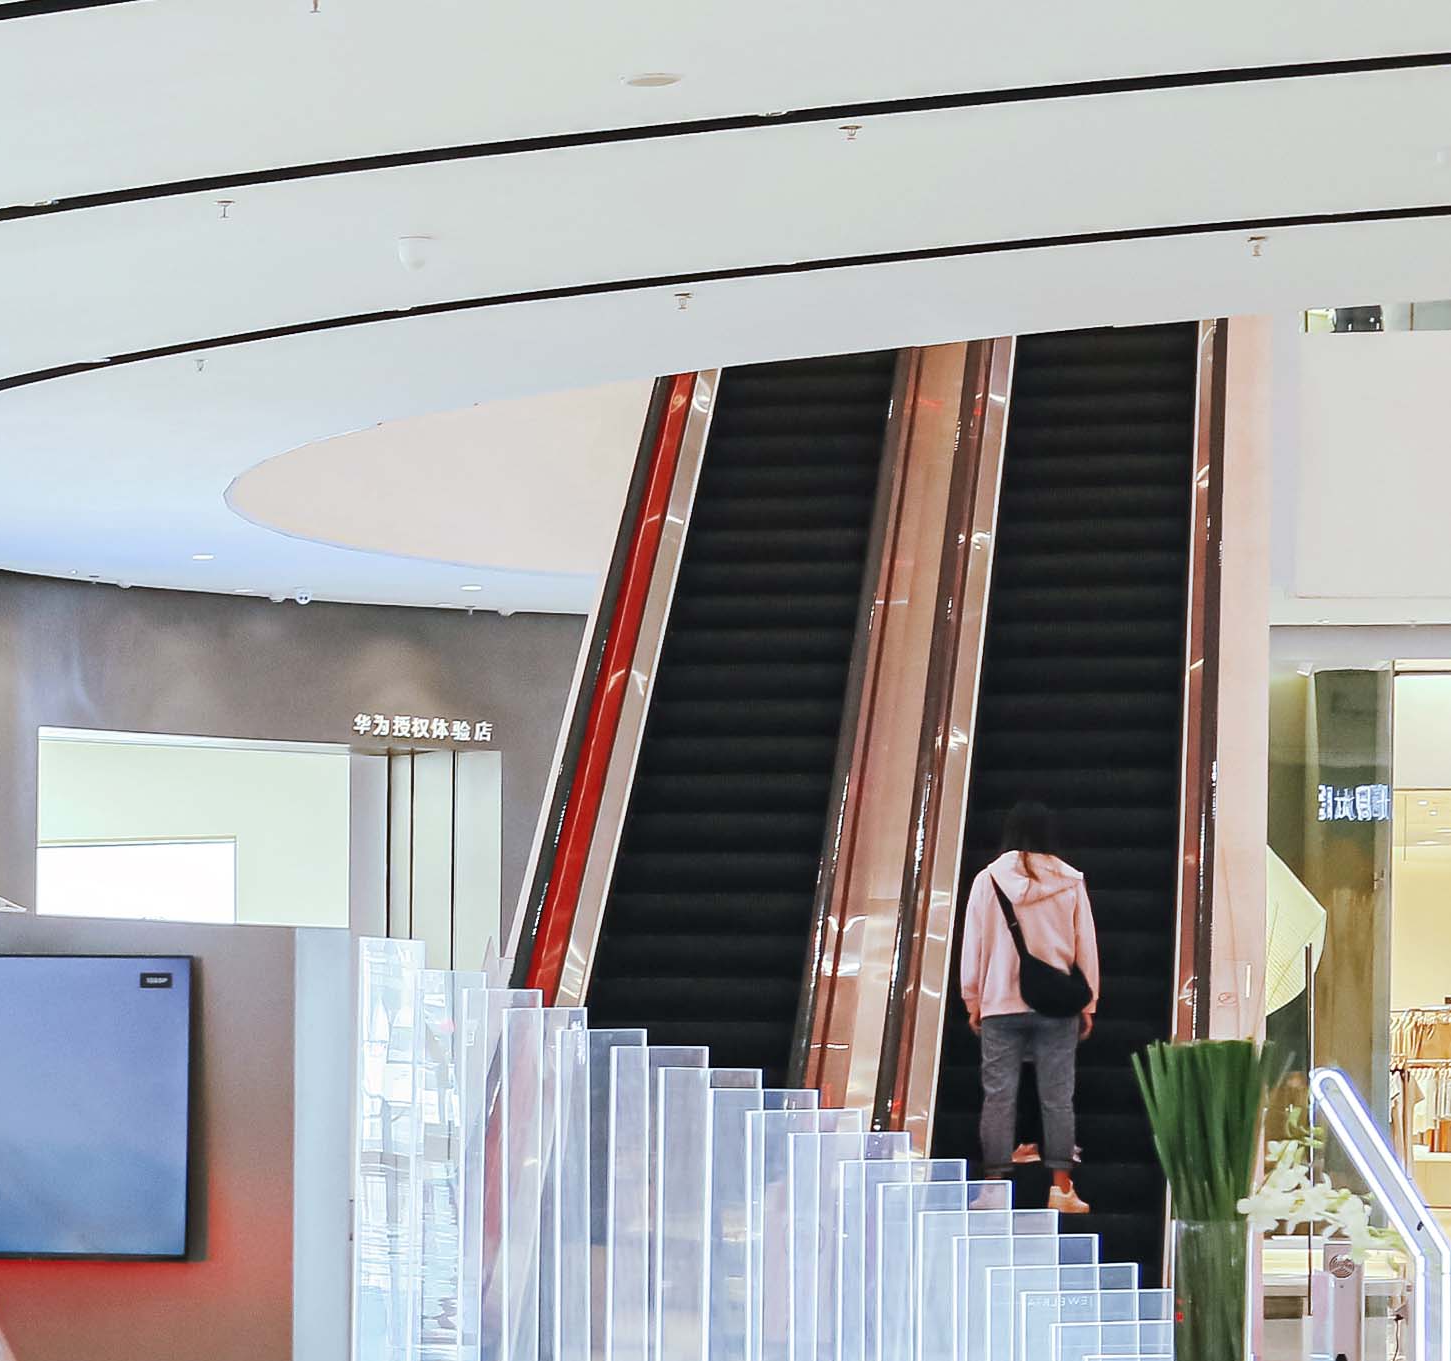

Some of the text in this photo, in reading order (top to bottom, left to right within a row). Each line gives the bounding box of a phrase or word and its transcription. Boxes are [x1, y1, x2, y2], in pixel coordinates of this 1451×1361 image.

[352, 712, 494, 742] 华为授权体验店
